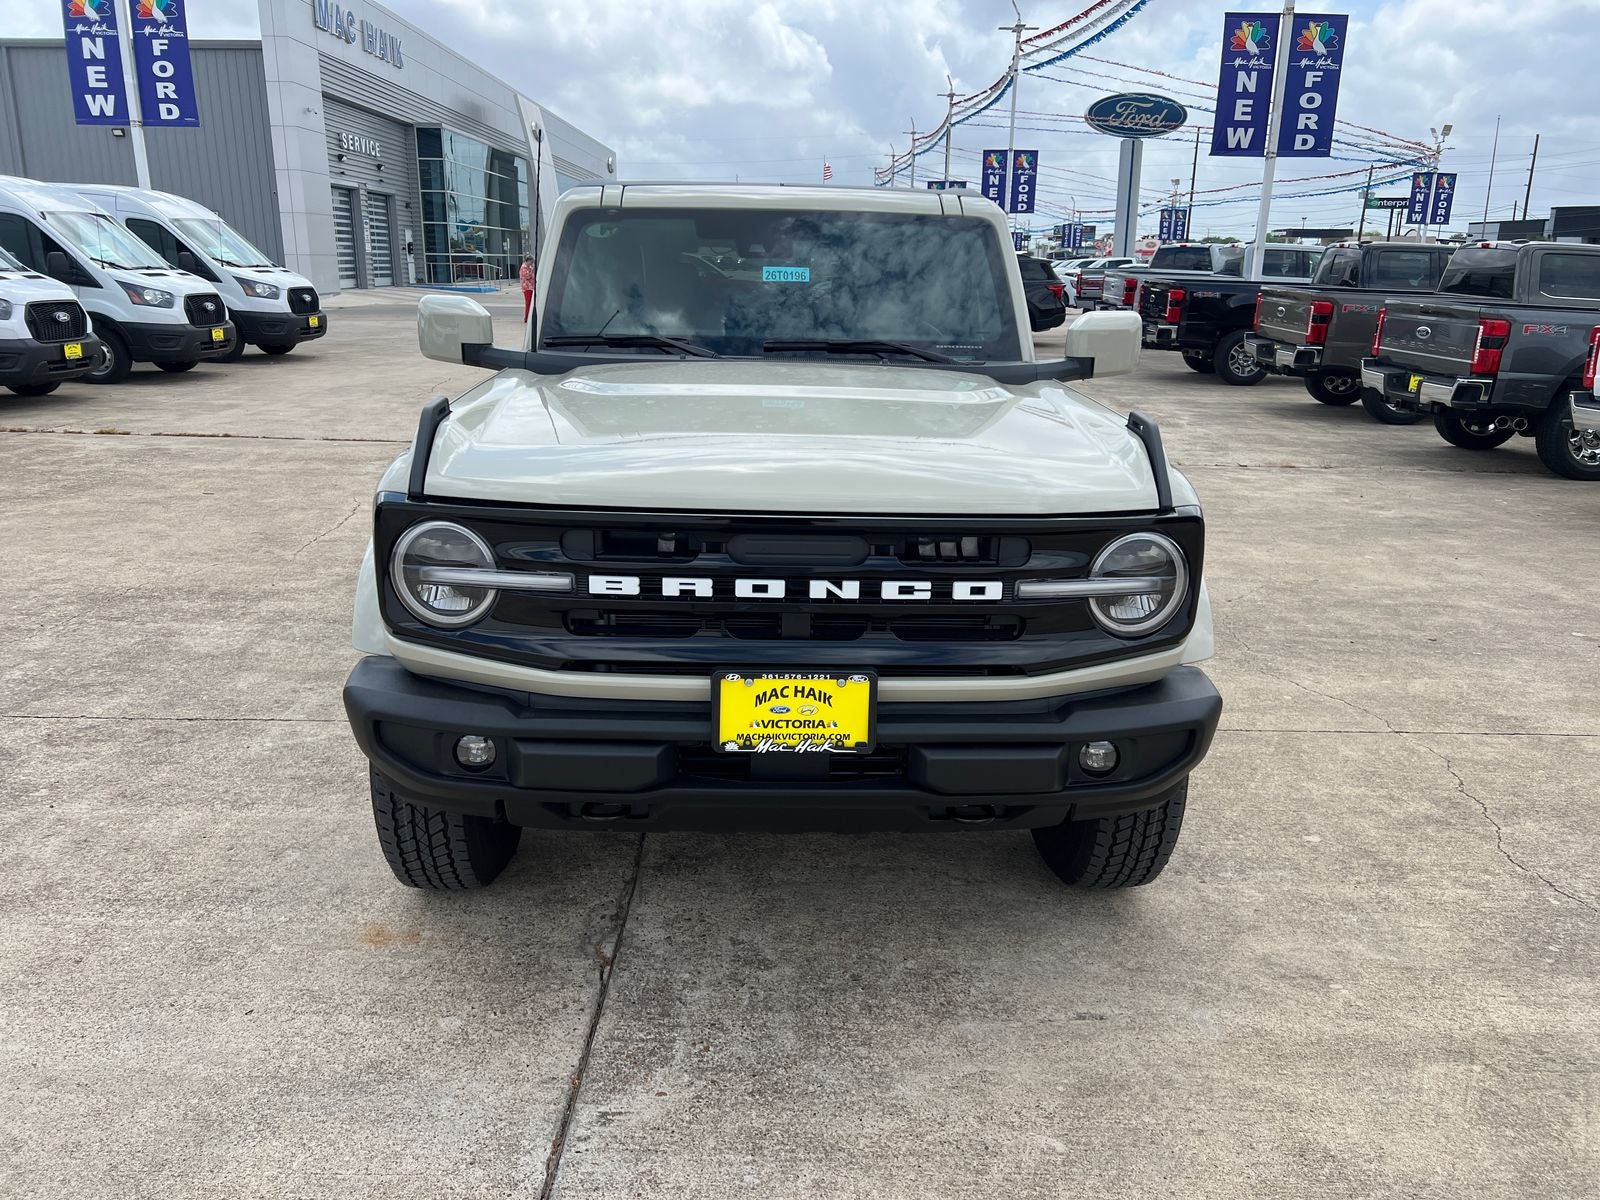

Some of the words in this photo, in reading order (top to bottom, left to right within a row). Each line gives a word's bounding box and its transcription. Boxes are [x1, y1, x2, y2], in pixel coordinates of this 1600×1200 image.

[314, 0, 356, 44] MAC
[361, 19, 404, 69] HAIK
[81, 37, 115, 117] NEW
[152, 39, 180, 120] FORD
[1110, 101, 1168, 127] Ford
[1226, 71, 1258, 149] NEW
[1293, 71, 1324, 150] FORD
[341, 132, 381, 157] SERVICE
[1017, 175, 1029, 211] FORD
[1411, 193, 1425, 222] NEW
[1435, 193, 1448, 223] FORD
[1161, 221, 1169, 239] NEW
[765, 270, 807, 280] 26T0196
[1342, 303, 1378, 313] FX4
[1523, 324, 1569, 336] FX4
[588, 575, 1003, 600] BRONCO
[755, 685, 790, 708] MAC
[793, 685, 833, 708] HAIK
[761, 719, 827, 729] VICTORIA
[736, 733, 851, 741] MACHAIKVICTORIA.COM
[755, 739, 791, 753] Mac
[793, 739, 836, 753] Haik
